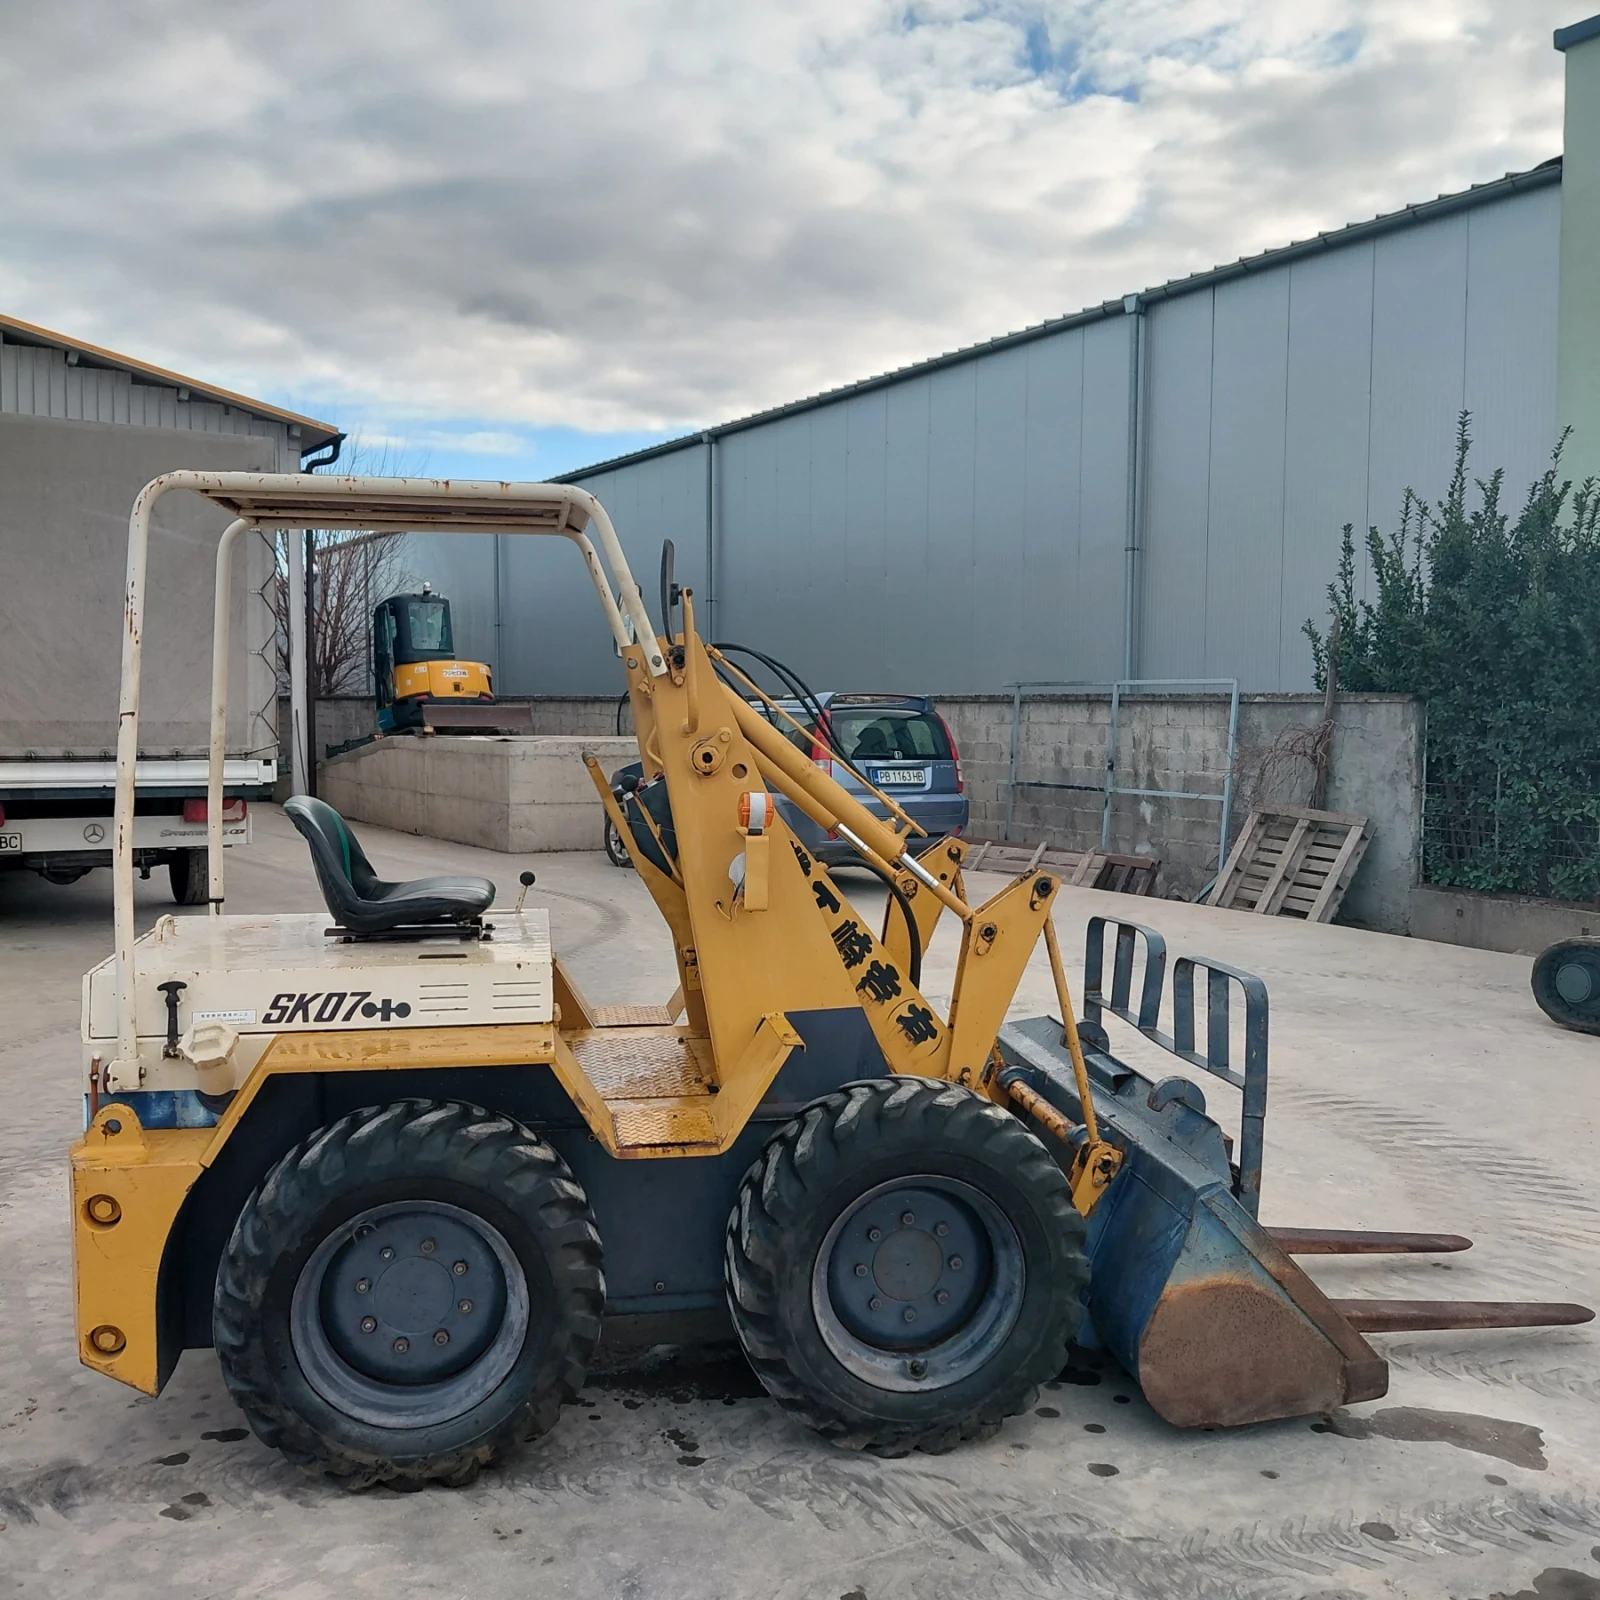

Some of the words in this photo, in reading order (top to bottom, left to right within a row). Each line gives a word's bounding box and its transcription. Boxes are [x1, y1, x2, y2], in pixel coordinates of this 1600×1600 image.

[880, 771, 892, 782] PB
[893, 771, 912, 782] 1163
[912, 771, 924, 782] HB
[262, 991, 372, 1024] SK07
